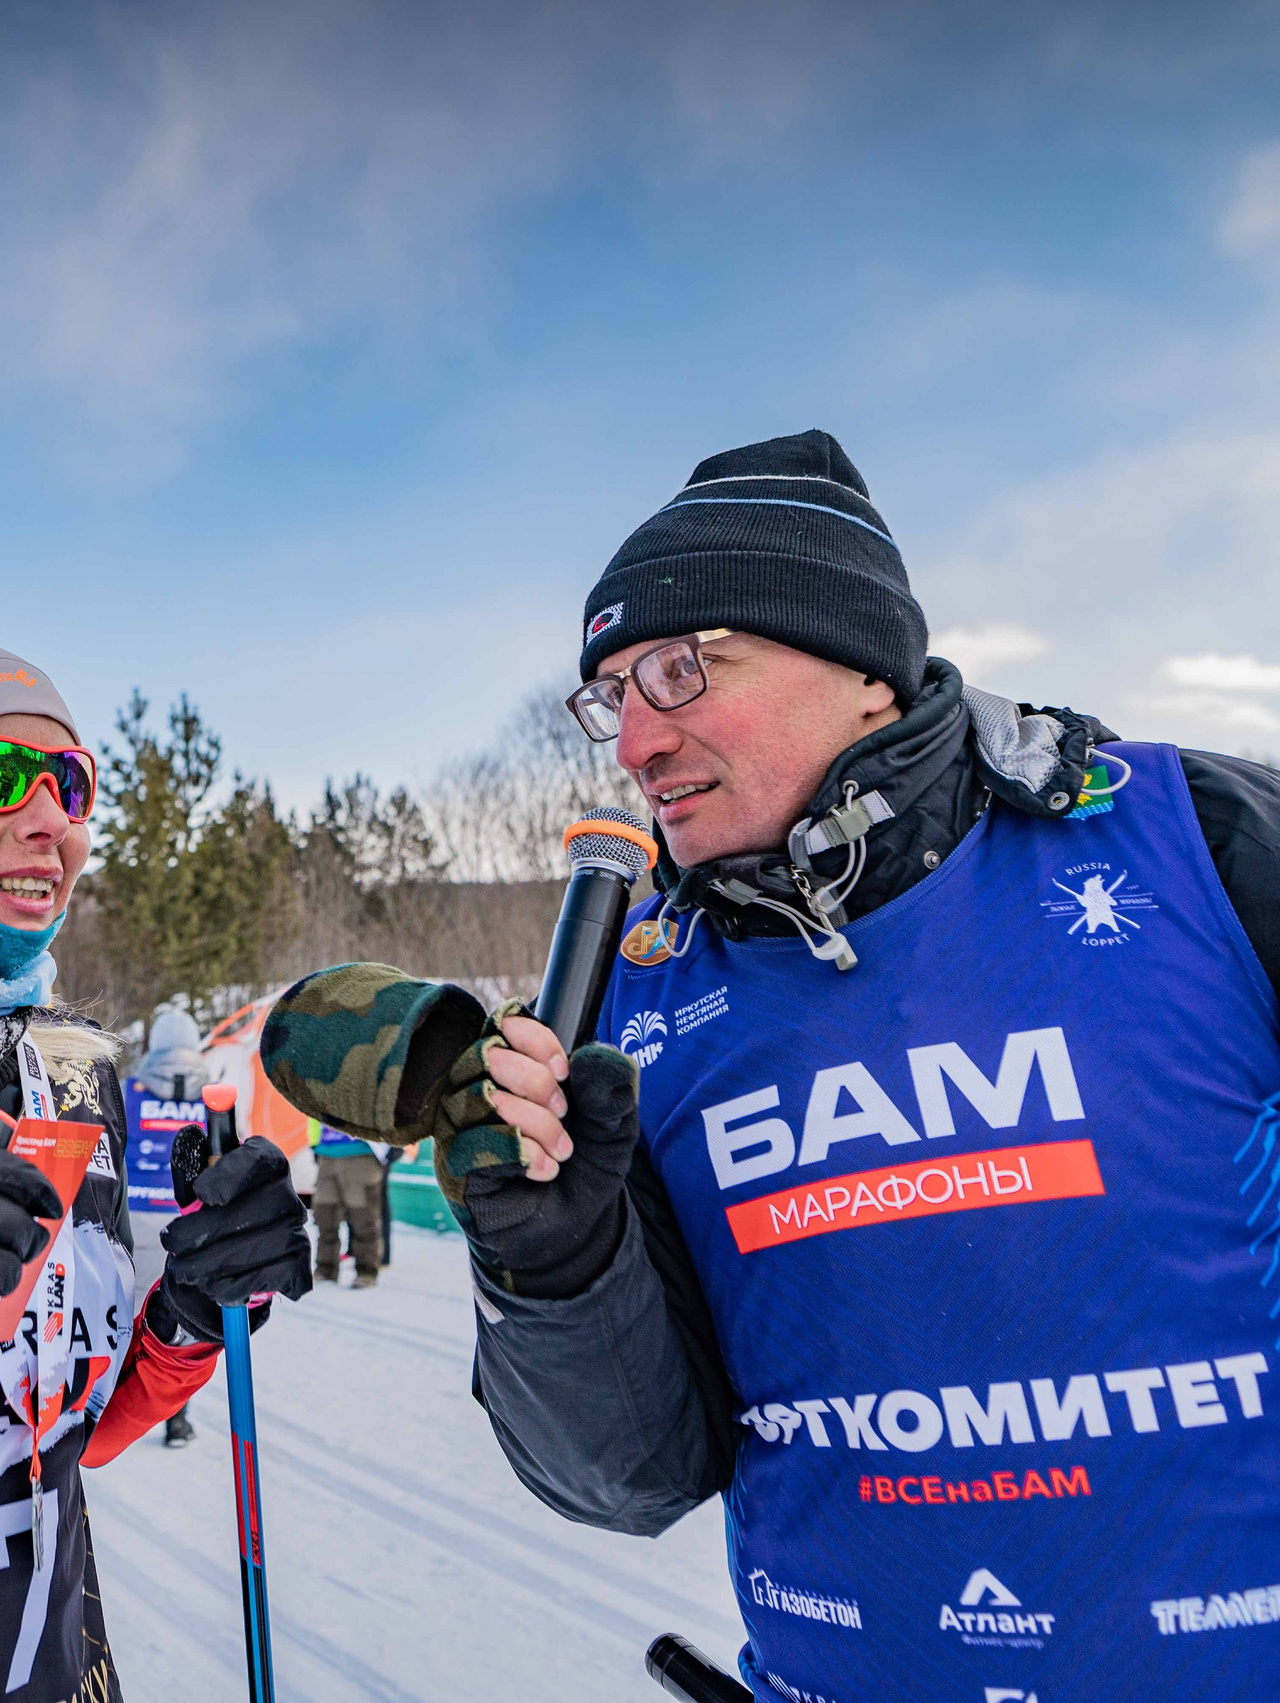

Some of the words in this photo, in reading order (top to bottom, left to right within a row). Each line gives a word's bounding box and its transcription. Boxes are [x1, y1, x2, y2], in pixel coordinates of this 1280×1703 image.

[1065, 862, 1111, 876] RUSSIA
[1081, 933, 1131, 947] LOPPET
[674, 986, 728, 1018] ИРКУТСКАЯ
[675, 996, 725, 1027] НЕФТЯНАЯ
[676, 1003, 730, 1036] КОМПАНИЯ
[141, 1101, 205, 1121] БАМ
[701, 1026, 1086, 1190] БАМ
[769, 1156, 1034, 1235] МАРАФОНЫ
[47, 1262, 55, 1308] KRAS
[54, 1263, 66, 1309] LAND
[859, 1467, 1091, 1505] #ВСЕнаБАМ
[770, 1587, 863, 1630] ГАЗОБЕТОН
